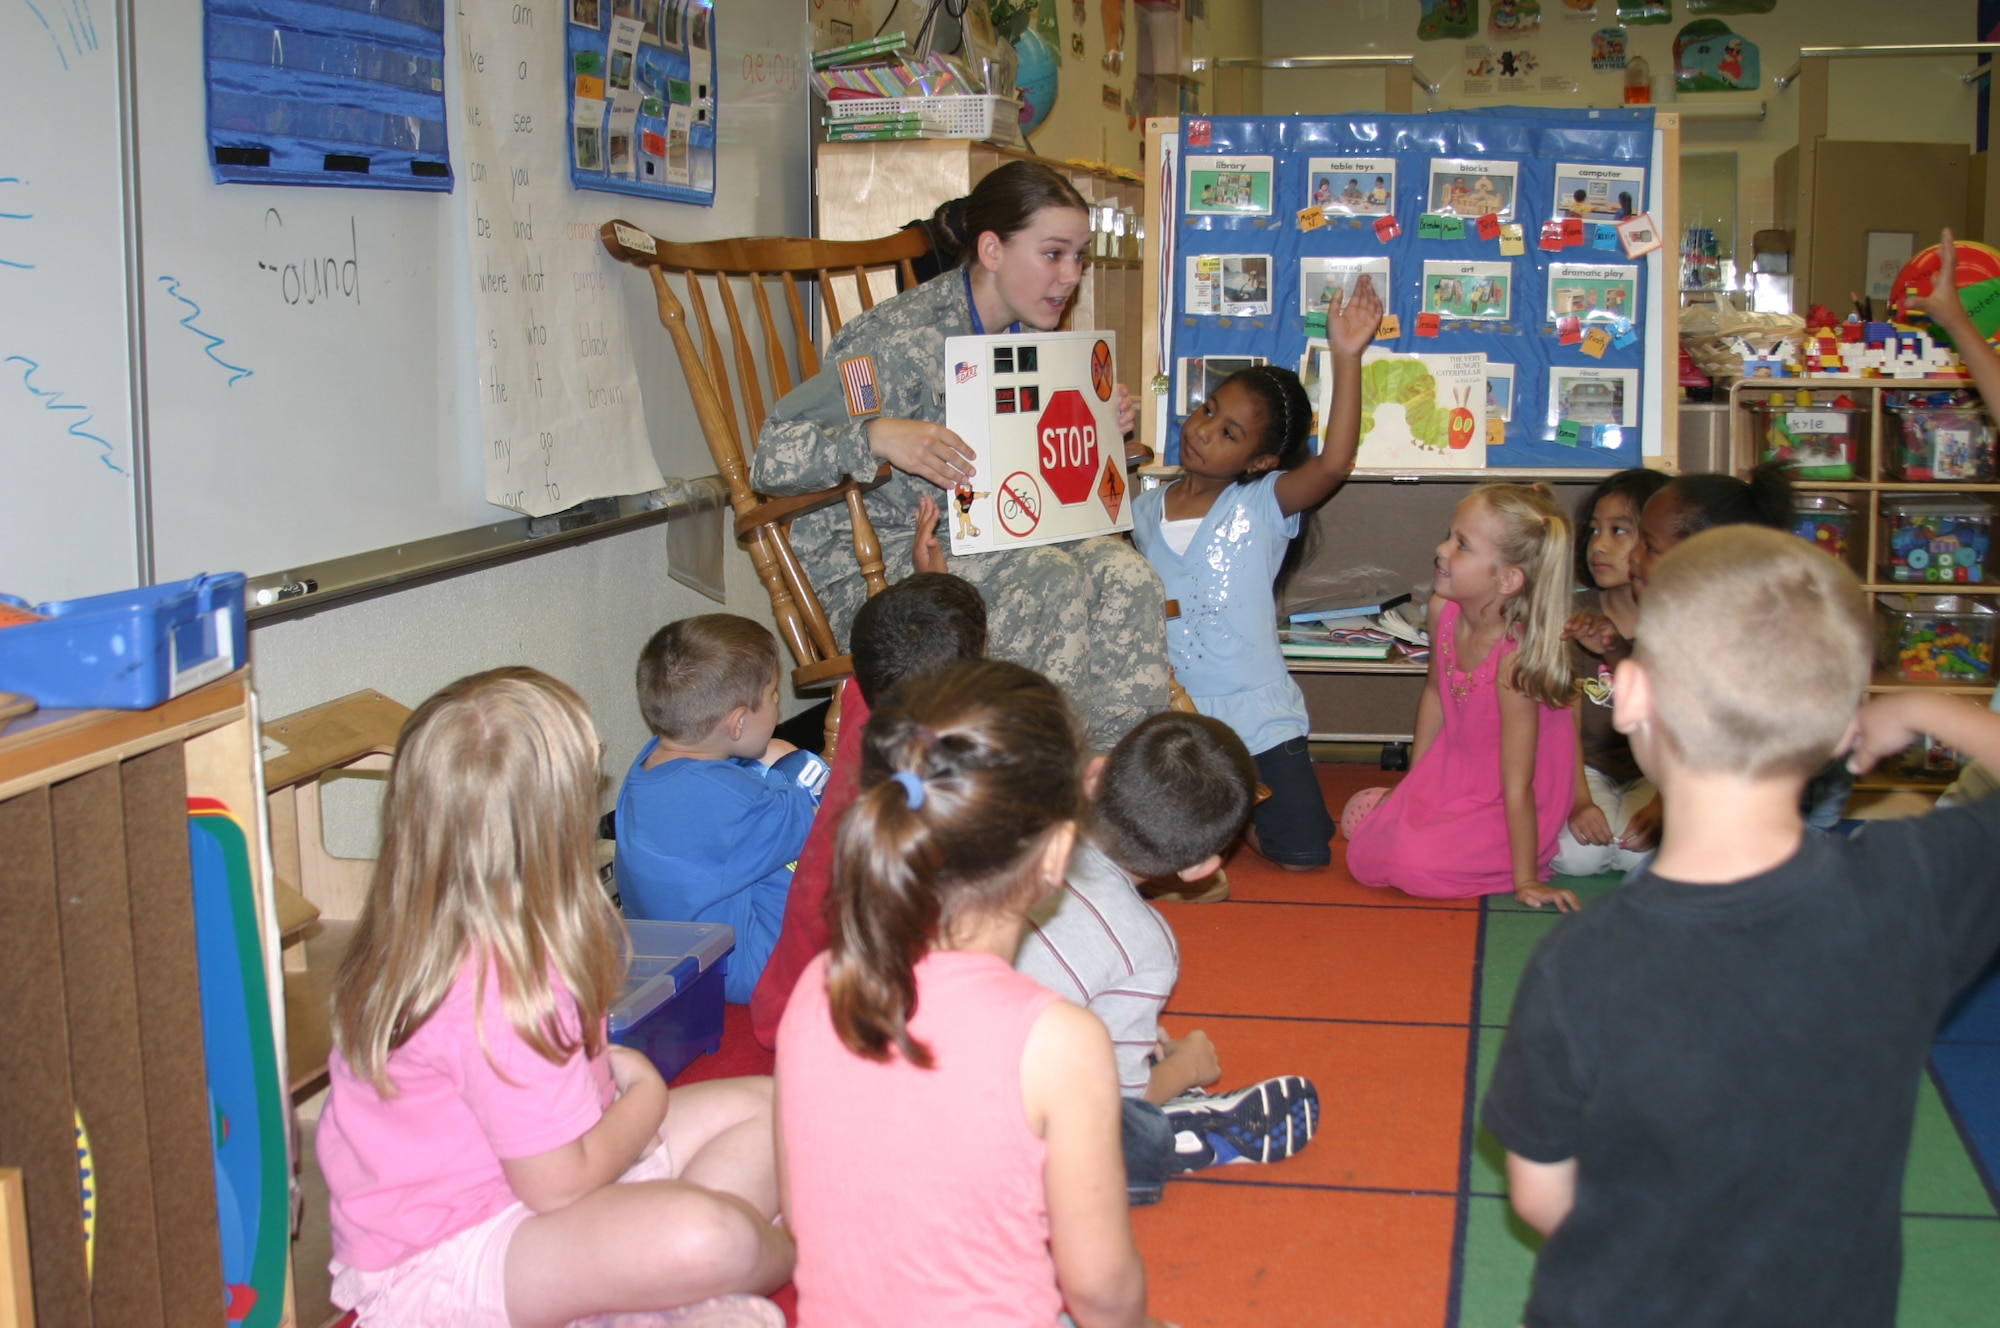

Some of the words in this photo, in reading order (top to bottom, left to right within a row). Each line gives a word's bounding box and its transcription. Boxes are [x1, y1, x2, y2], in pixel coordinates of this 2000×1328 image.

[512, 4, 533, 28] am
[518, 60, 528, 80] a
[465, 106, 482, 127] we
[514, 114, 533, 134] see
[471, 161, 488, 184] can
[1215, 161, 1246, 171] library
[1330, 162, 1352, 171] table
[1356, 163, 1375, 172] toys
[1460, 164, 1489, 173] blocks
[1578, 168, 1622, 179] computer
[510, 166, 530, 202] you
[476, 199, 491, 240] be
[513, 203, 534, 242] and
[479, 256, 508, 293] where
[520, 256, 545, 293] what
[573, 253, 605, 304] purple
[1561, 268, 1602, 277] dramatic
[1603, 269, 1625, 279] play
[487, 329, 498, 350] is
[526, 308, 547, 346] who
[579, 322, 609, 358] black
[490, 366, 508, 404] the
[534, 362, 543, 398] it
[1436, 369, 1481, 377] CATERPILLAR
[586, 374, 624, 409] brown
[494, 438, 511, 474] my
[540, 432, 554, 467] go
[1042, 425, 1096, 470] STOP
[545, 467, 560, 503] to
